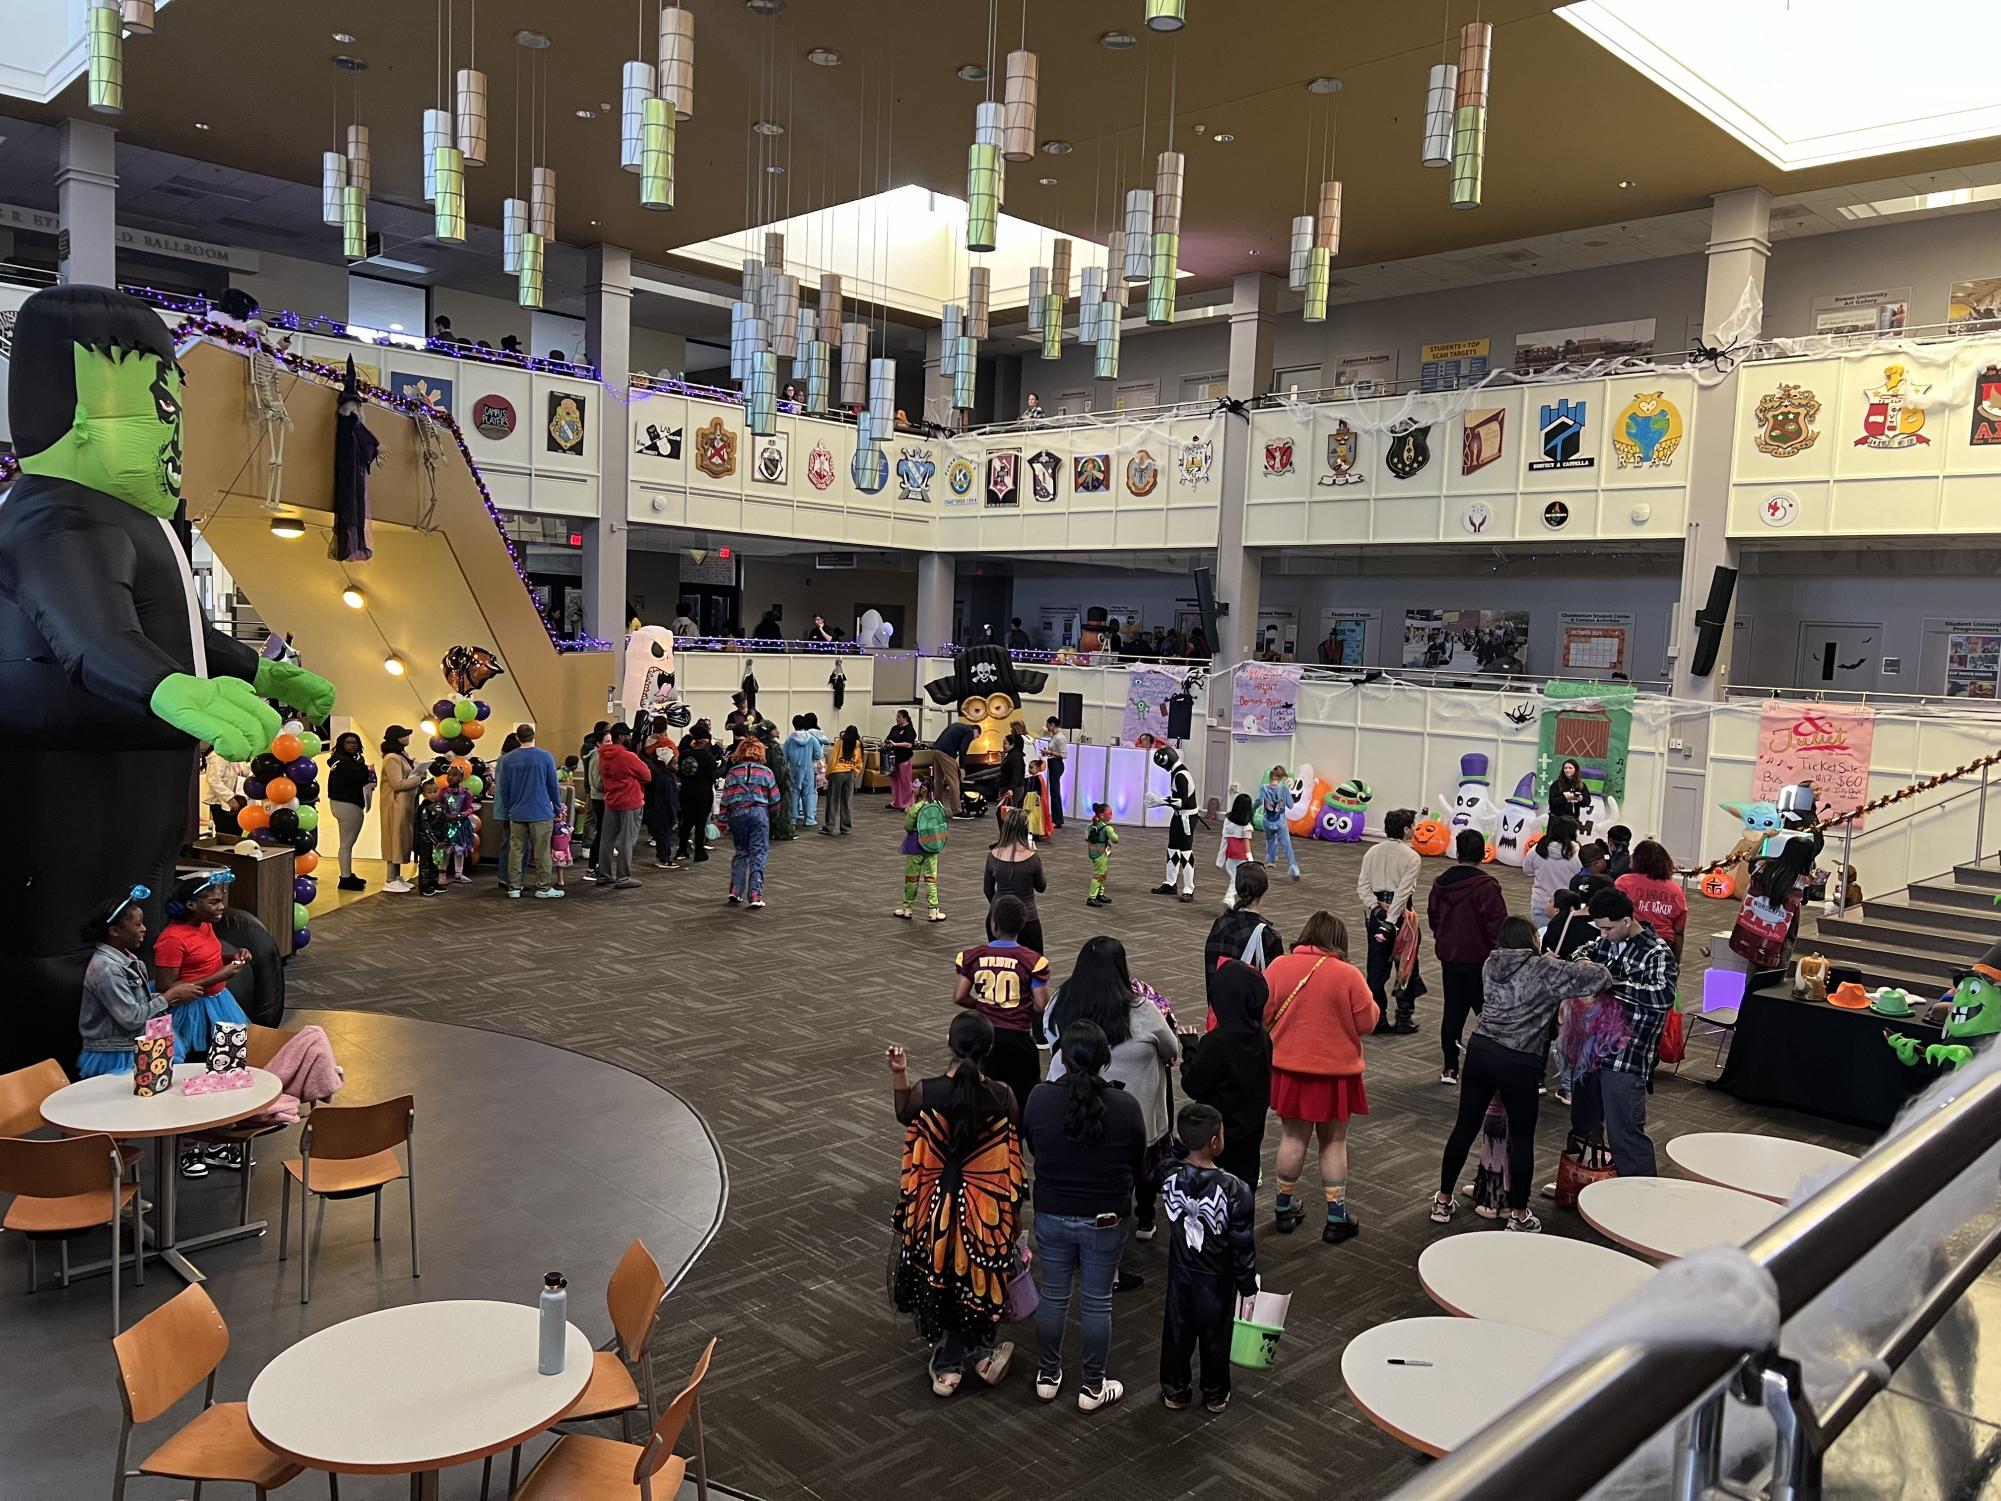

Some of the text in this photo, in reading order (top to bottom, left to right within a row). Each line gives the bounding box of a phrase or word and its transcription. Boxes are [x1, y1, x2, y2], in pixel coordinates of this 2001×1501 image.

[144, 235, 229, 260] BALLROOM
[1430, 343, 1462, 353] STUDENTS
[1467, 341, 1480, 349] TOP
[1449, 349, 1477, 358] TARGETS
[484, 406, 507, 418] CAMPUS
[1769, 727, 1847, 753] Juliet
[1797, 756, 1836, 770] Ticket
[1763, 771, 1783, 784] Bus
[1836, 775, 1863, 787] $60
[1639, 900, 1672, 915] THE BAKER
[974, 969, 1020, 1008] 30
